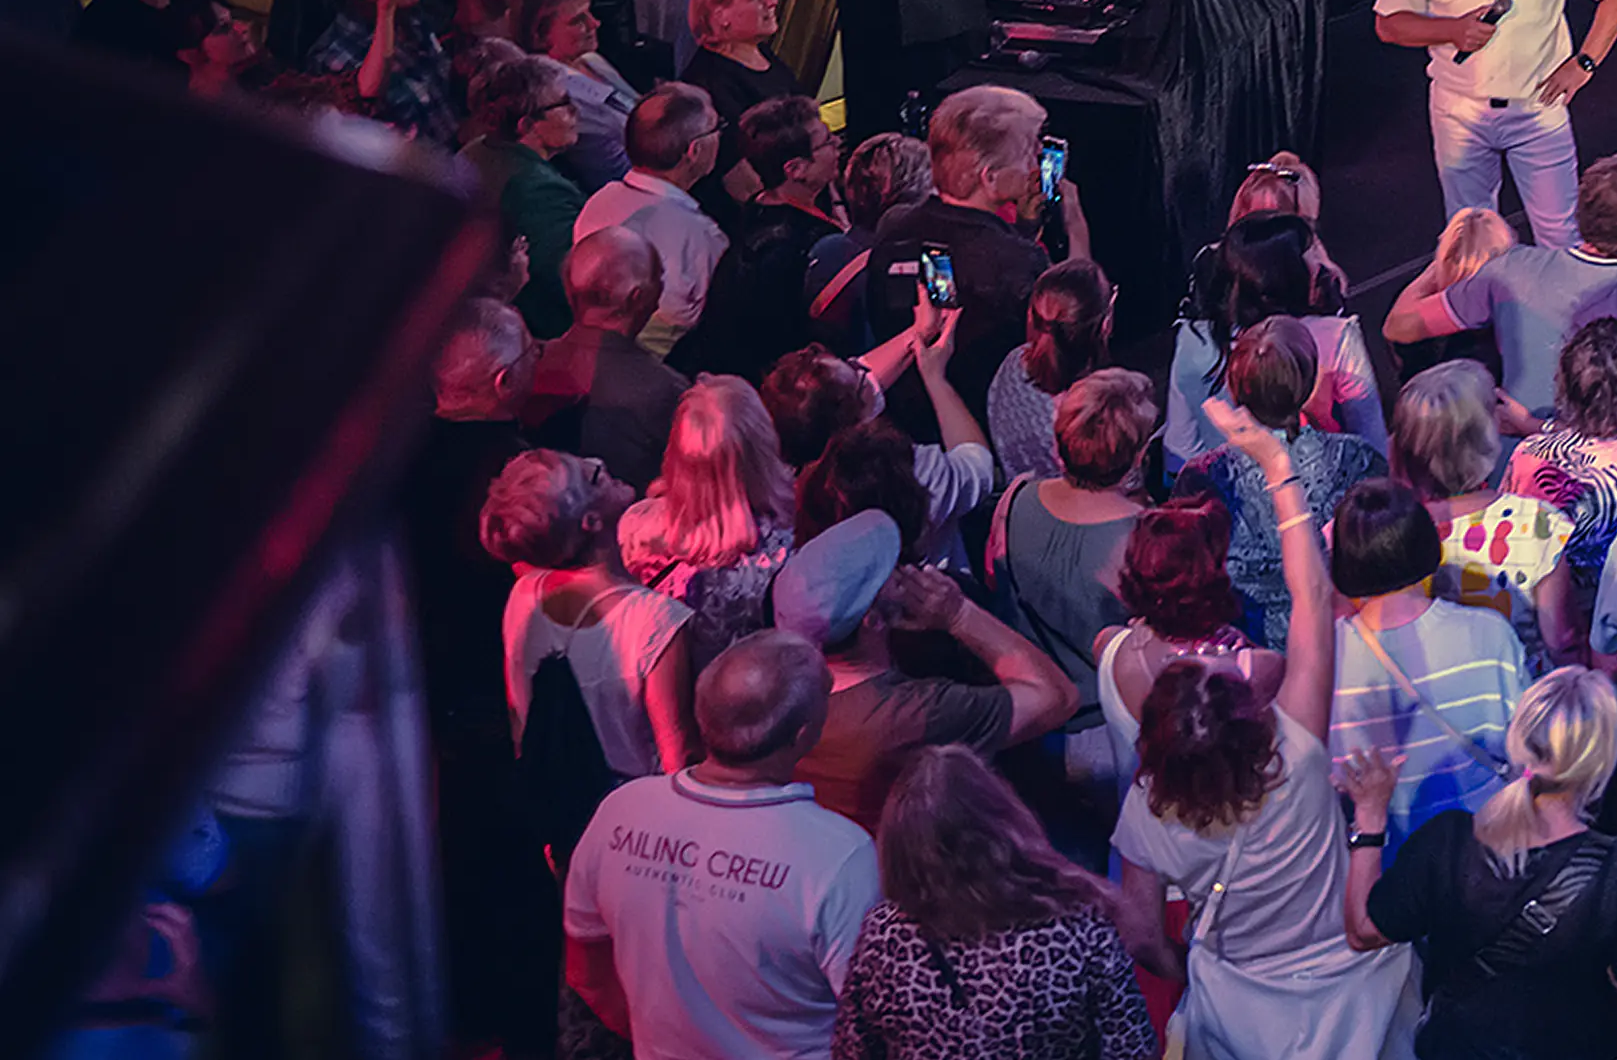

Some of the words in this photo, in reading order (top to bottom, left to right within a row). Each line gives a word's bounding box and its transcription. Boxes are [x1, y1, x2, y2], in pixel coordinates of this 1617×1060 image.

[609, 825, 700, 868] SAILING
[707, 850, 791, 890] CREW
[625, 864, 702, 891] AUTHENTIC
[709, 884, 746, 904] CLUB
